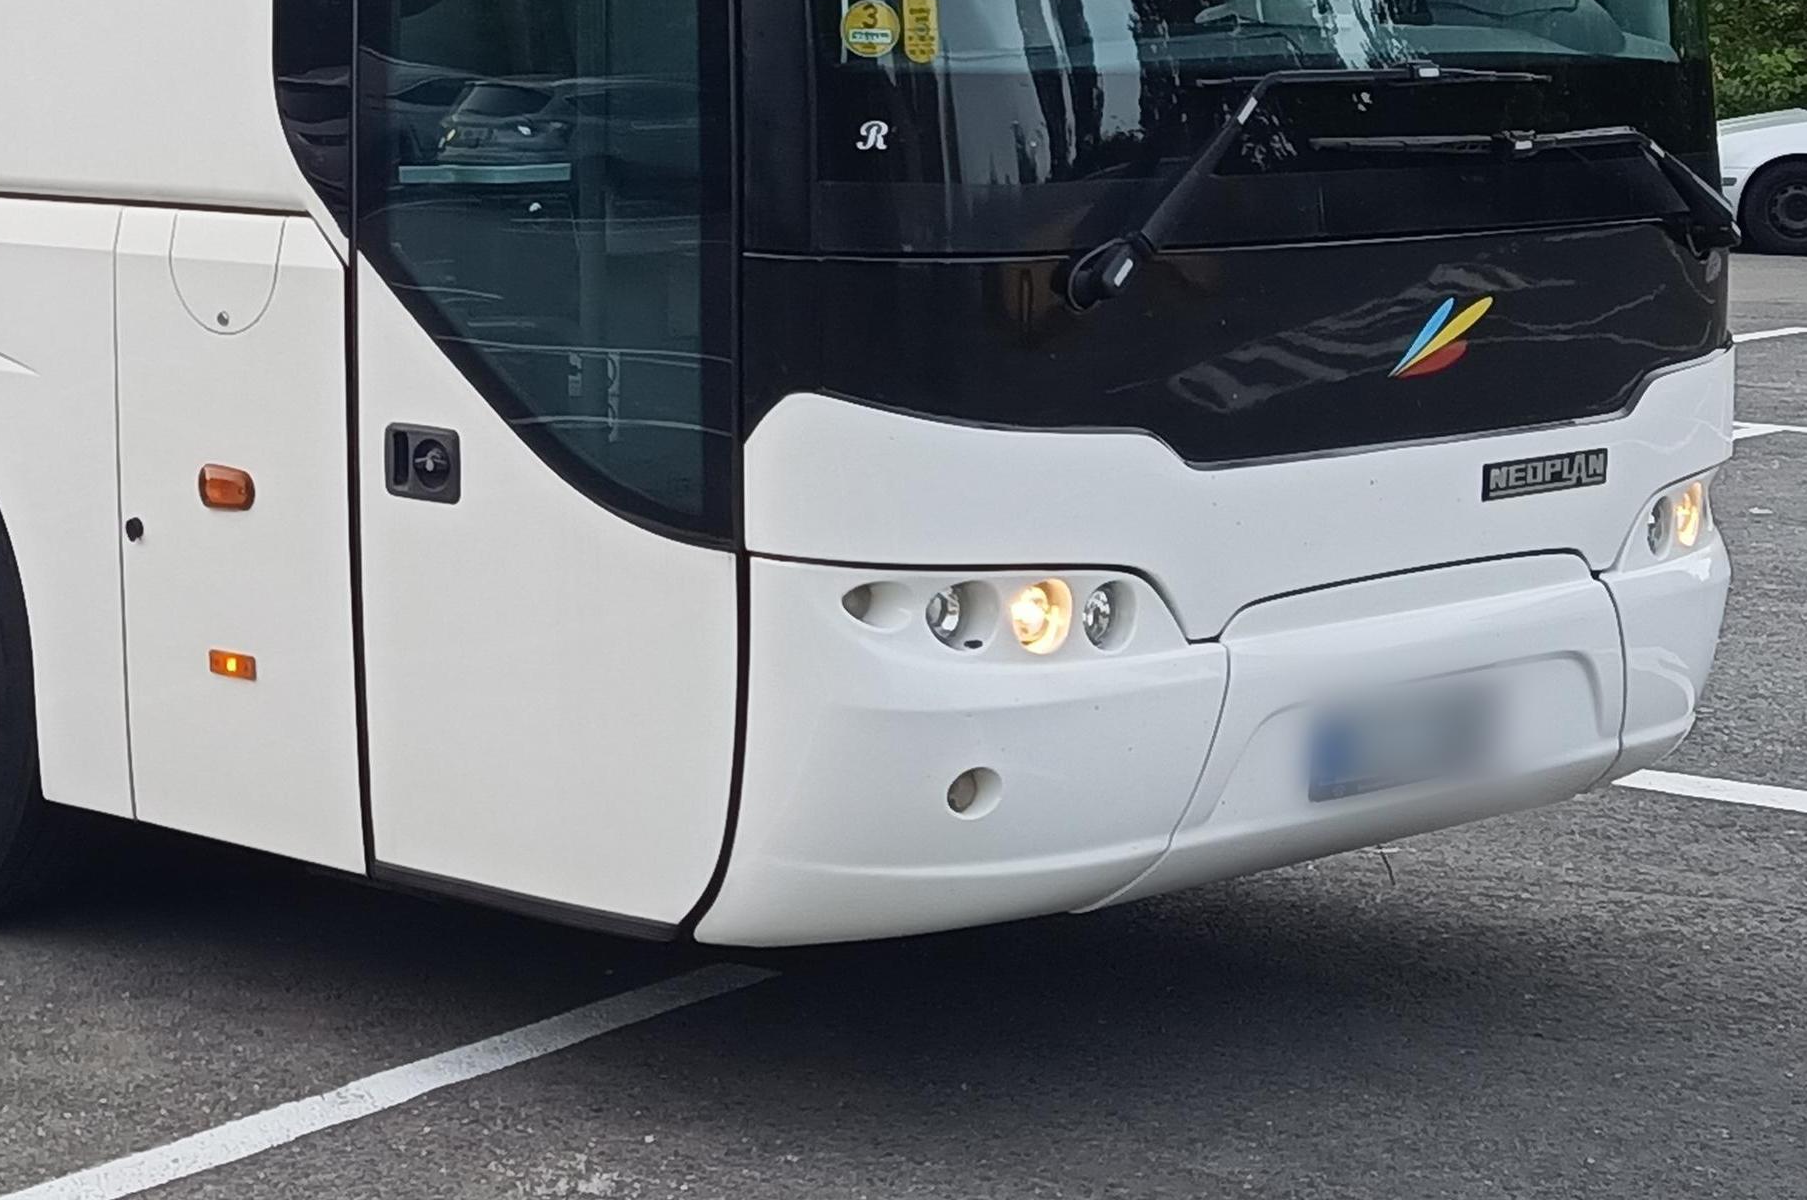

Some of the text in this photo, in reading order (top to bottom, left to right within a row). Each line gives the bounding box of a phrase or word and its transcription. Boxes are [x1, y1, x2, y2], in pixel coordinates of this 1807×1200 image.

[862, 4, 878, 28] 3
[856, 121, 889, 150] R
[1489, 452, 1605, 492] NEOPLAN
